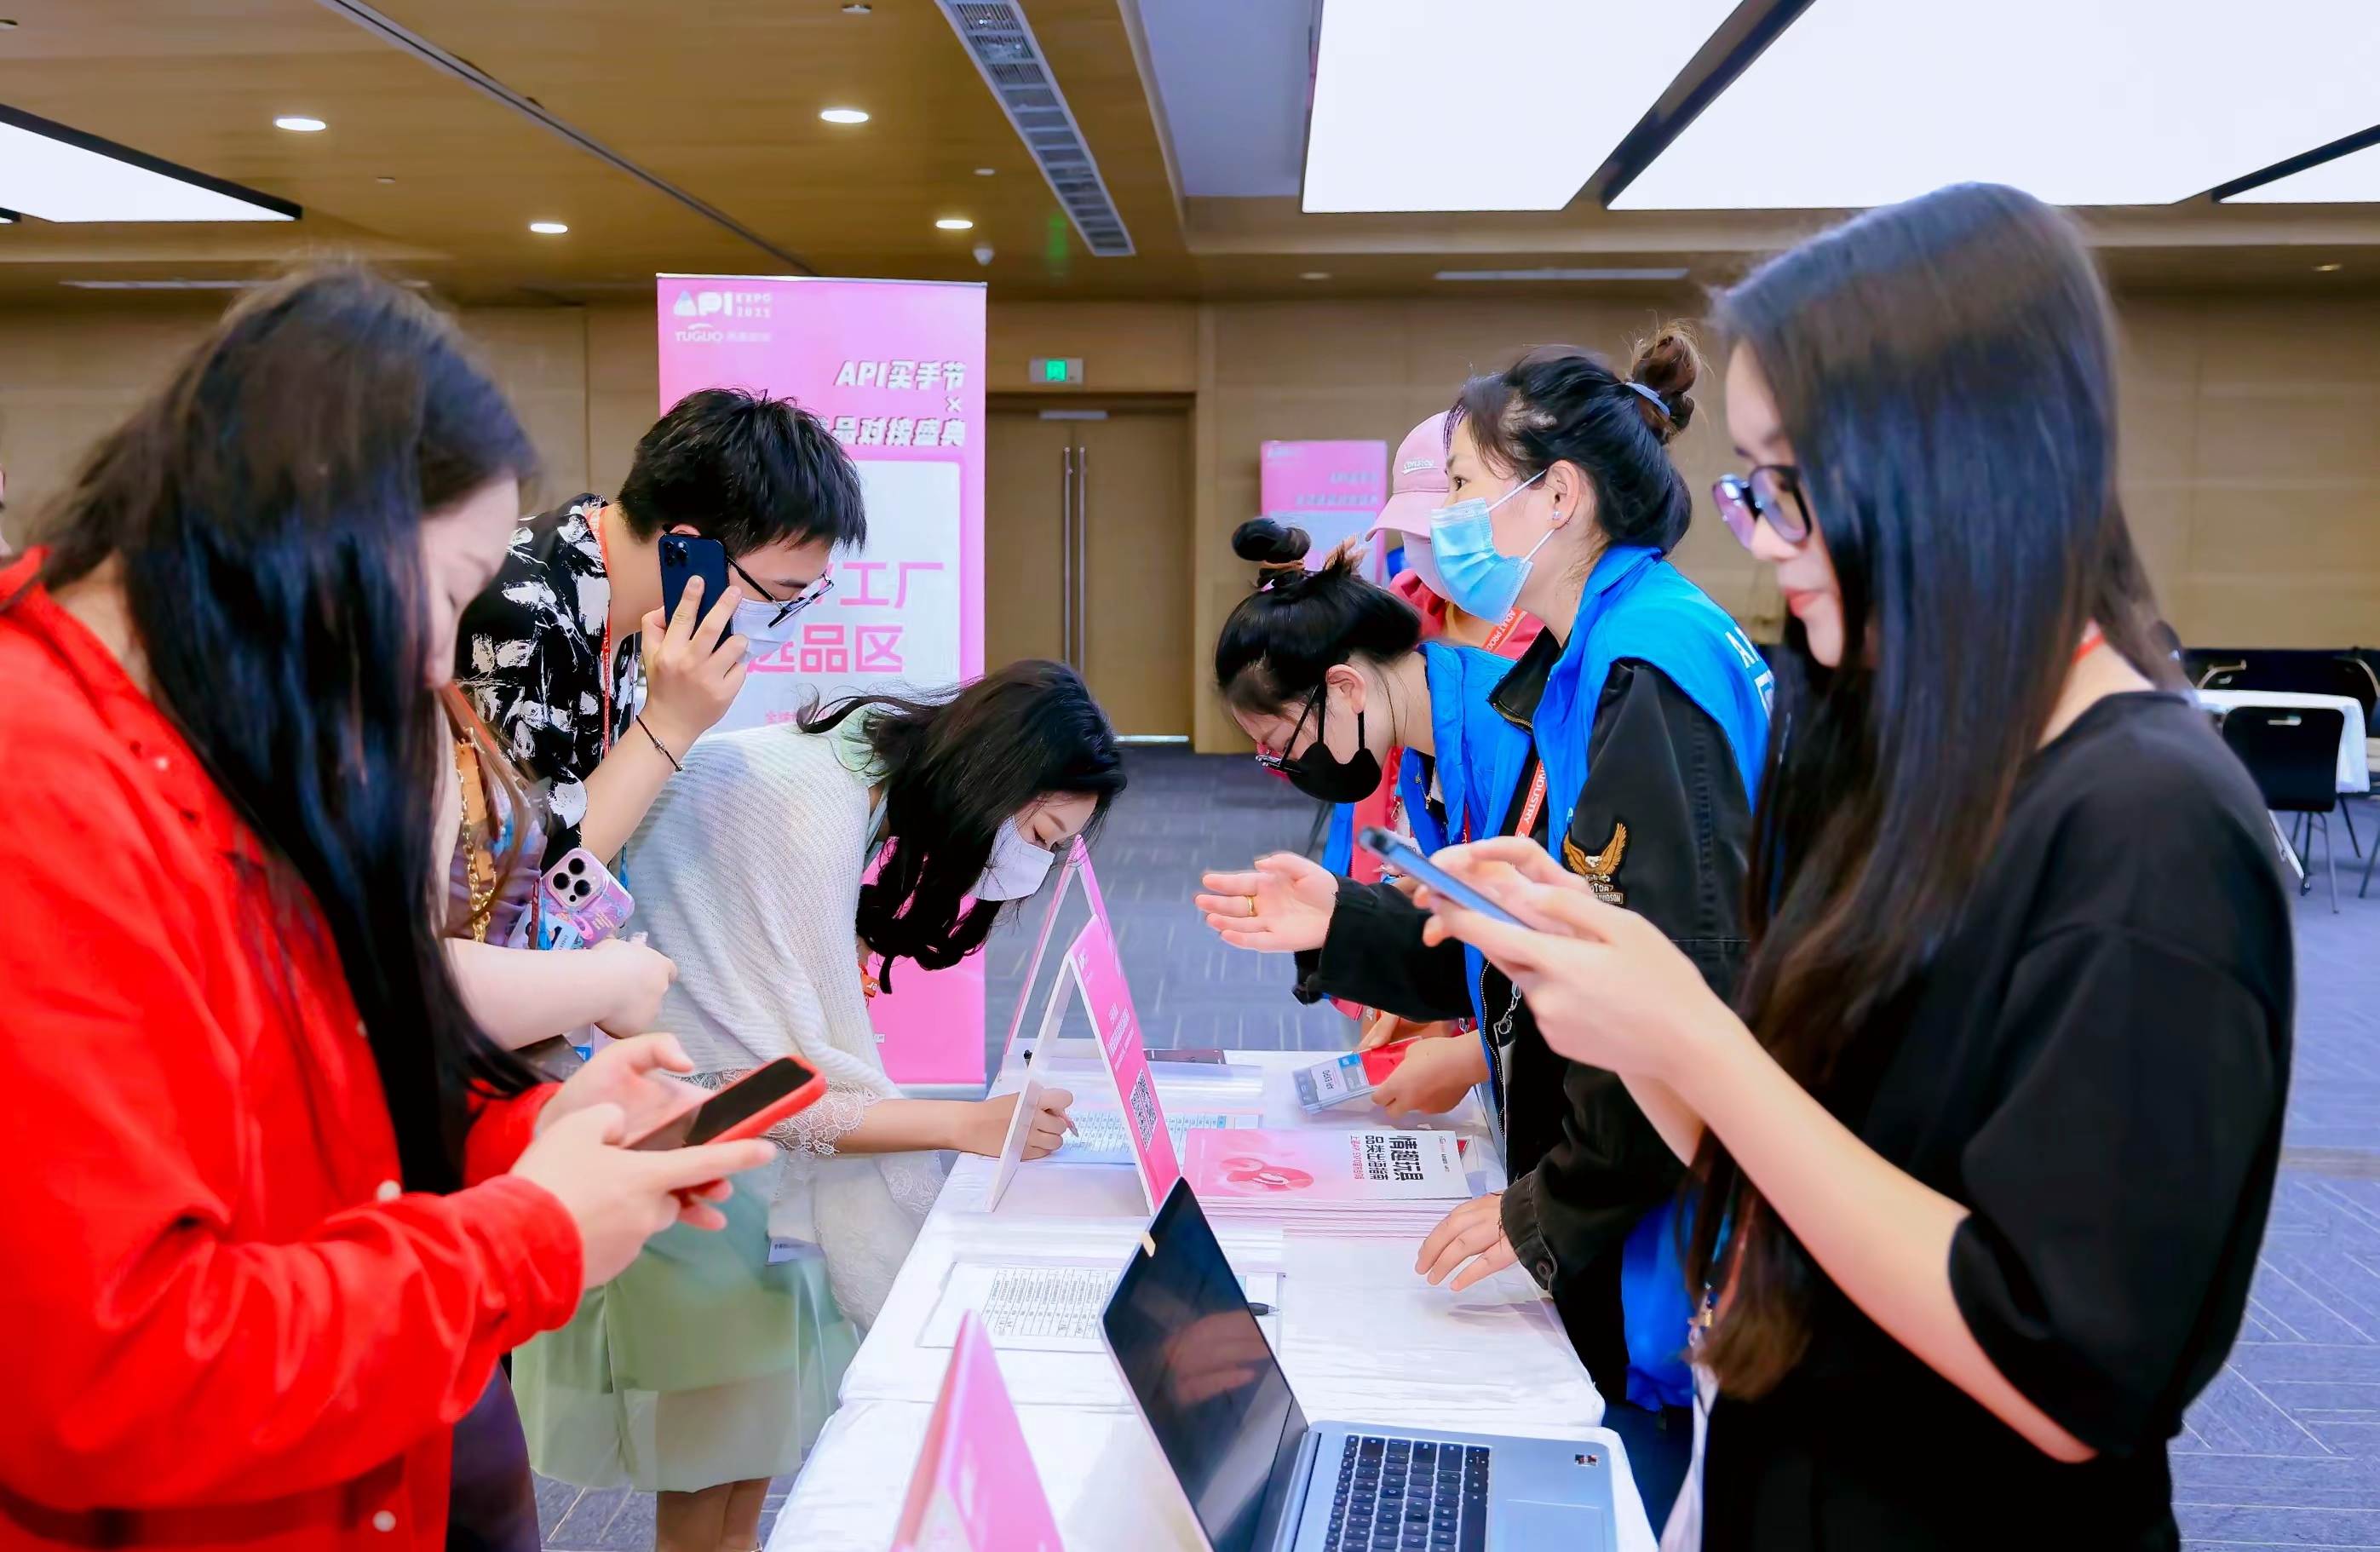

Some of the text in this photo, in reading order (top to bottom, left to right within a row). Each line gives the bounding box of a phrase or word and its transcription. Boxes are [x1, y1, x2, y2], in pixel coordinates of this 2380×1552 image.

[673, 290, 733, 316] API
[833, 360, 966, 391] API买手节
[818, 416, 966, 447] 品对接盛典
[815, 561, 945, 609] 工厂
